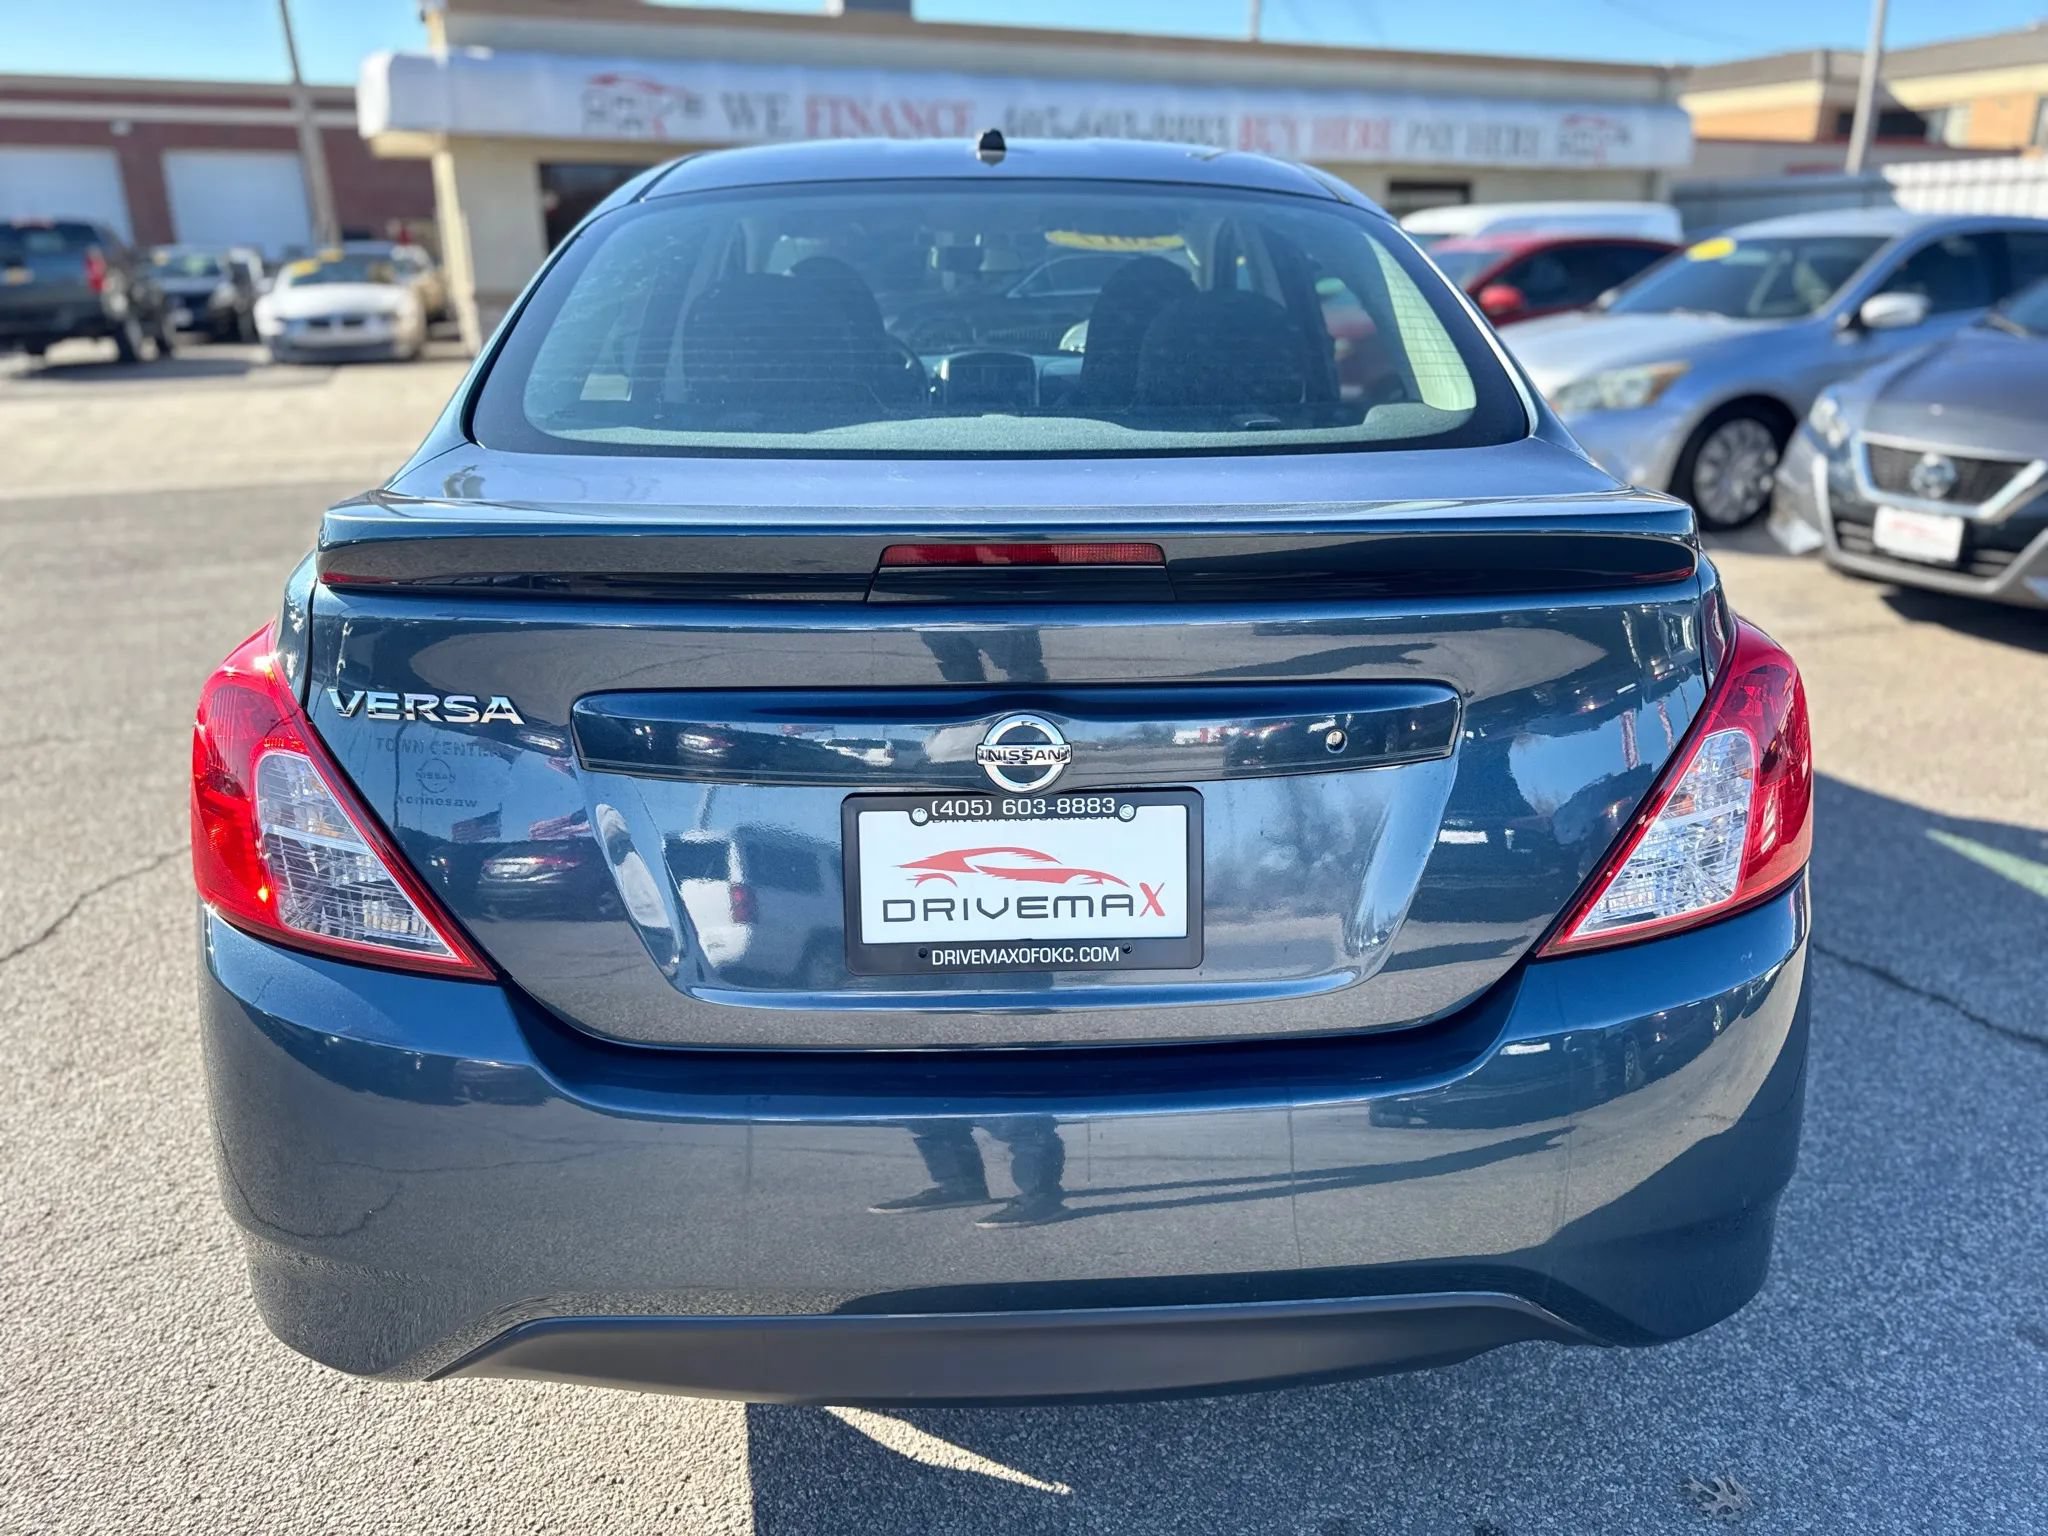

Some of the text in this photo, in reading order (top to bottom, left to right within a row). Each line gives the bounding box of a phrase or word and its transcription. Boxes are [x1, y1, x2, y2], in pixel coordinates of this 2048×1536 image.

[327, 687, 526, 725] VERSA
[988, 749, 1061, 762] NISSAN
[932, 798, 1116, 817] (405) 603-8883
[883, 882, 1166, 923] DRIVEMAX
[931, 946, 1120, 965] DRIVEMAXOFOKC.COM
